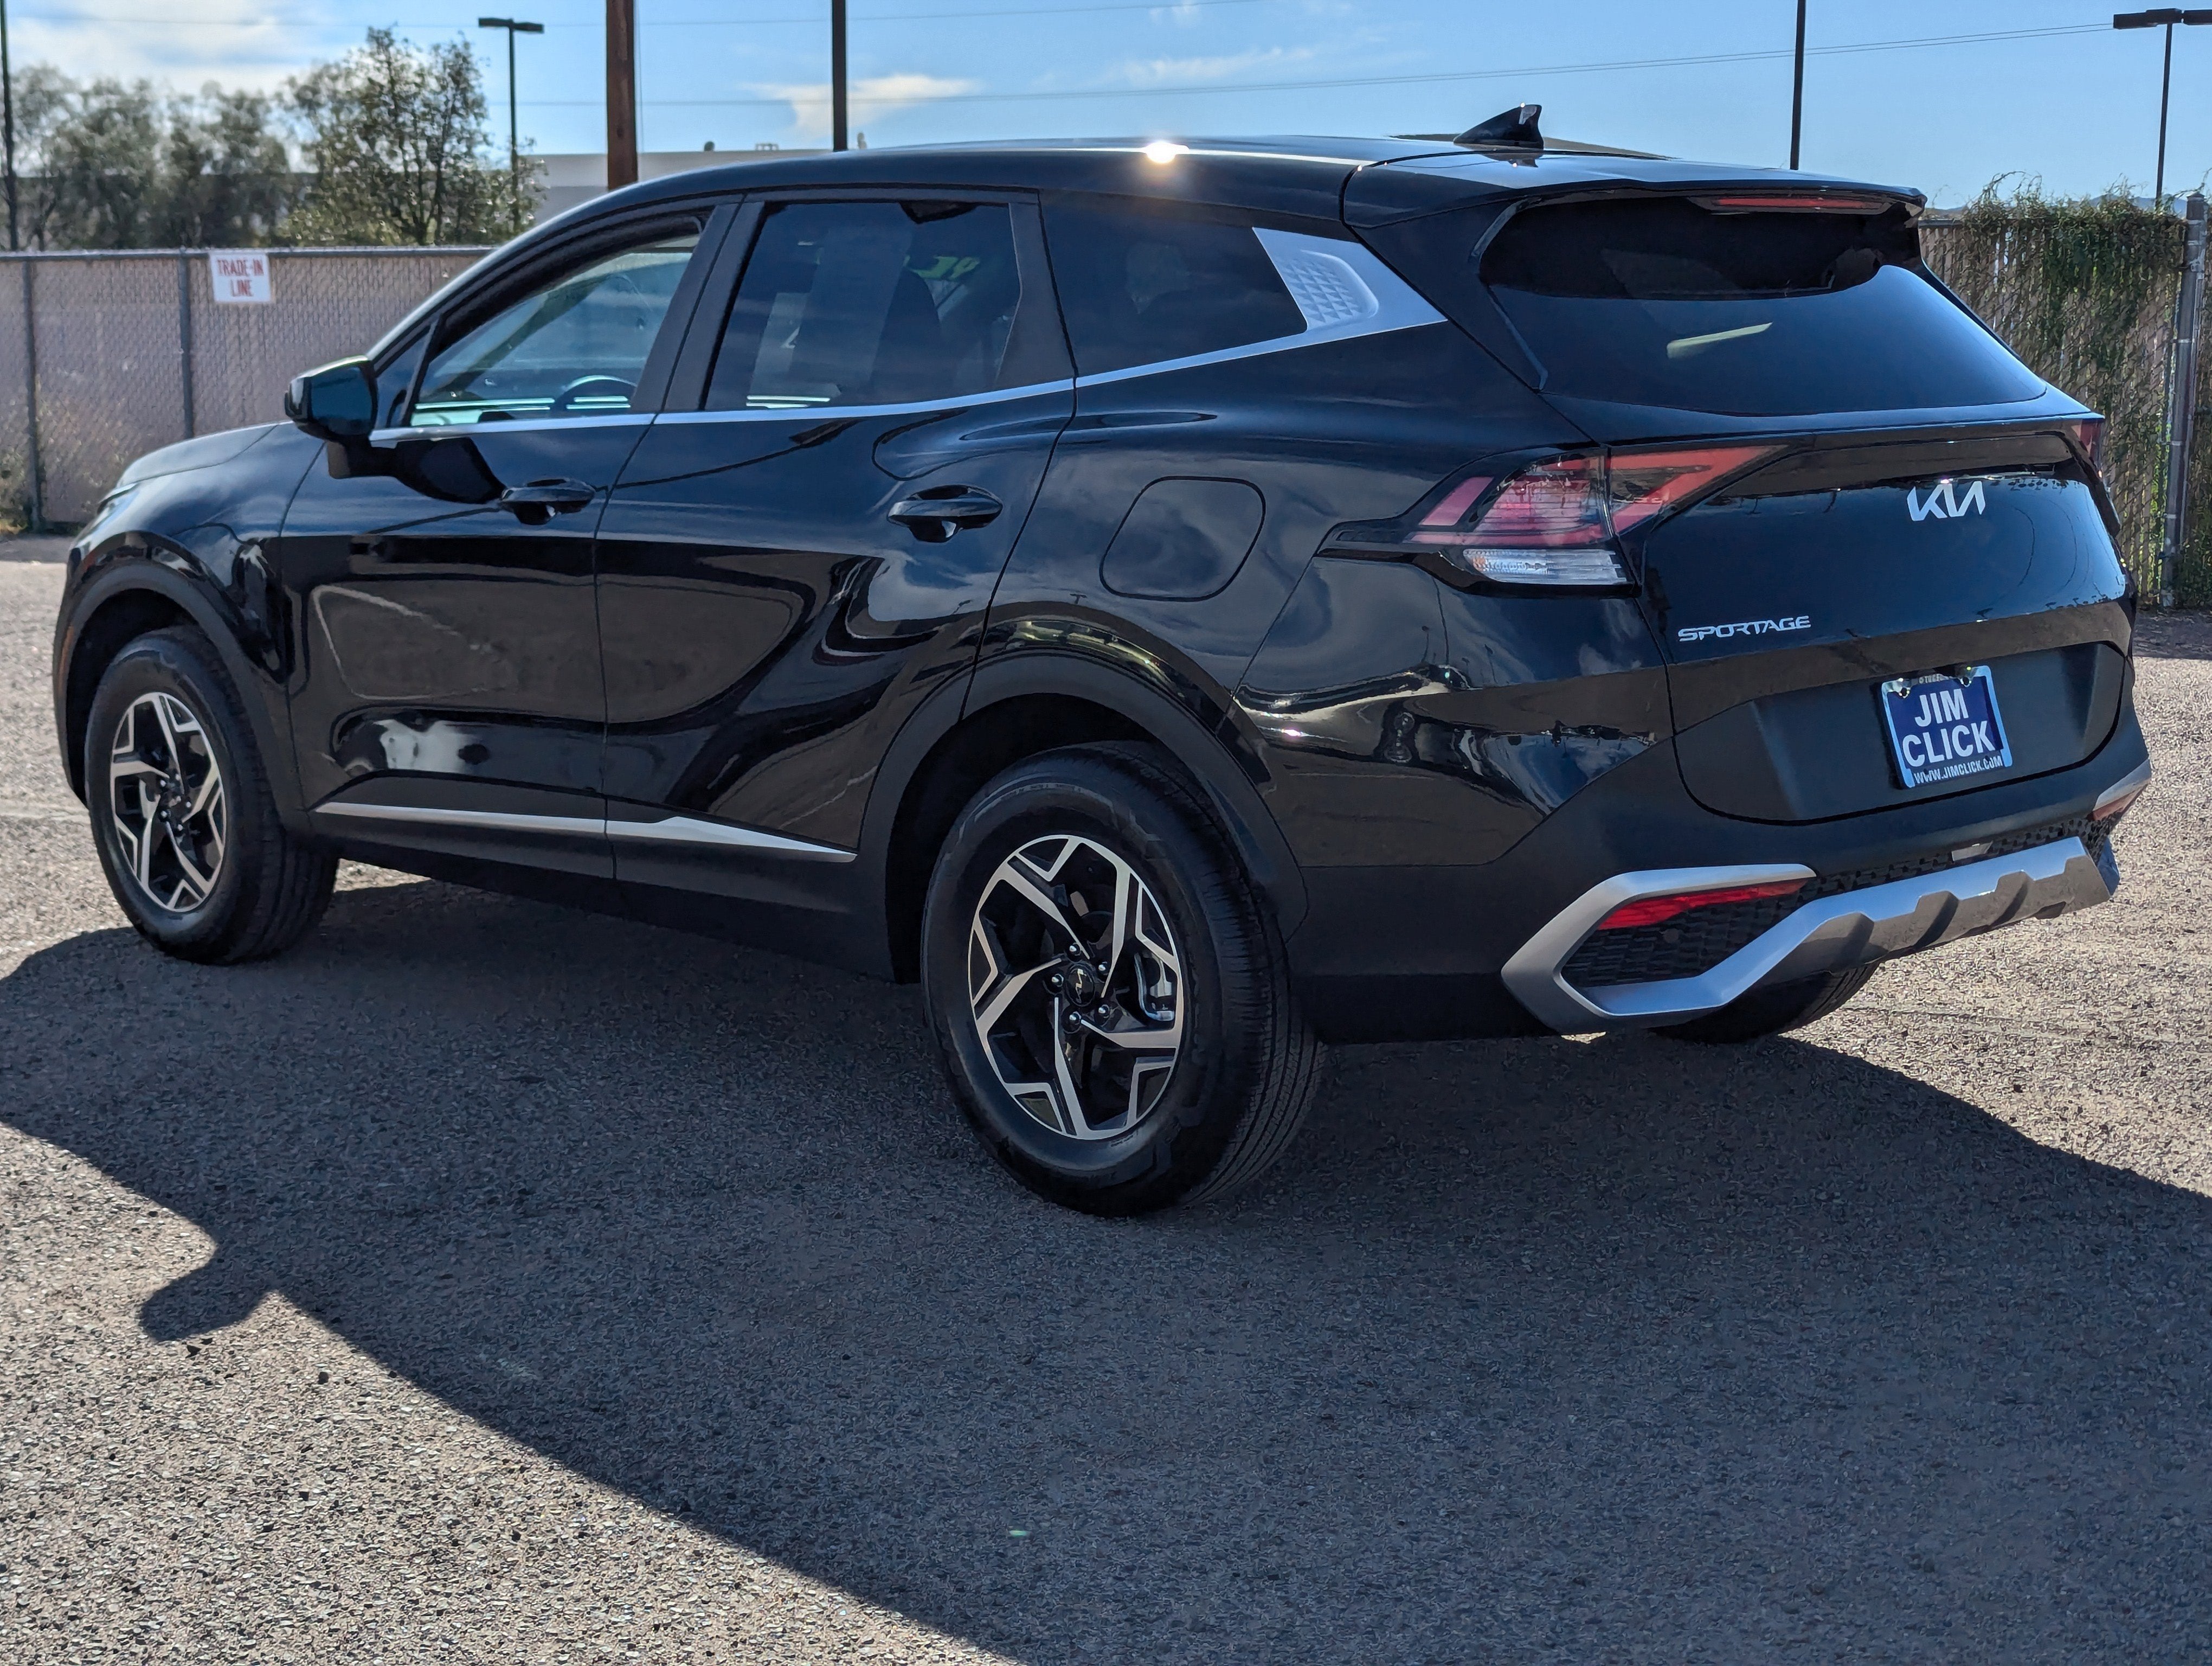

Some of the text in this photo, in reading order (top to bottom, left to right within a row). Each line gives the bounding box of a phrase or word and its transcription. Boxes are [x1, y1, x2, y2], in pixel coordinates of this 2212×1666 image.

[217, 259, 264, 277] TRADE-IN
[230, 279, 253, 297] LINE
[1907, 480, 1985, 521] KIA
[1678, 616, 1811, 642] SPORTAGE
[1914, 688, 1969, 727] JIM
[1902, 720, 1996, 767] CLICK
[1914, 755, 2003, 784] WWW.JIMCLICK.COM
